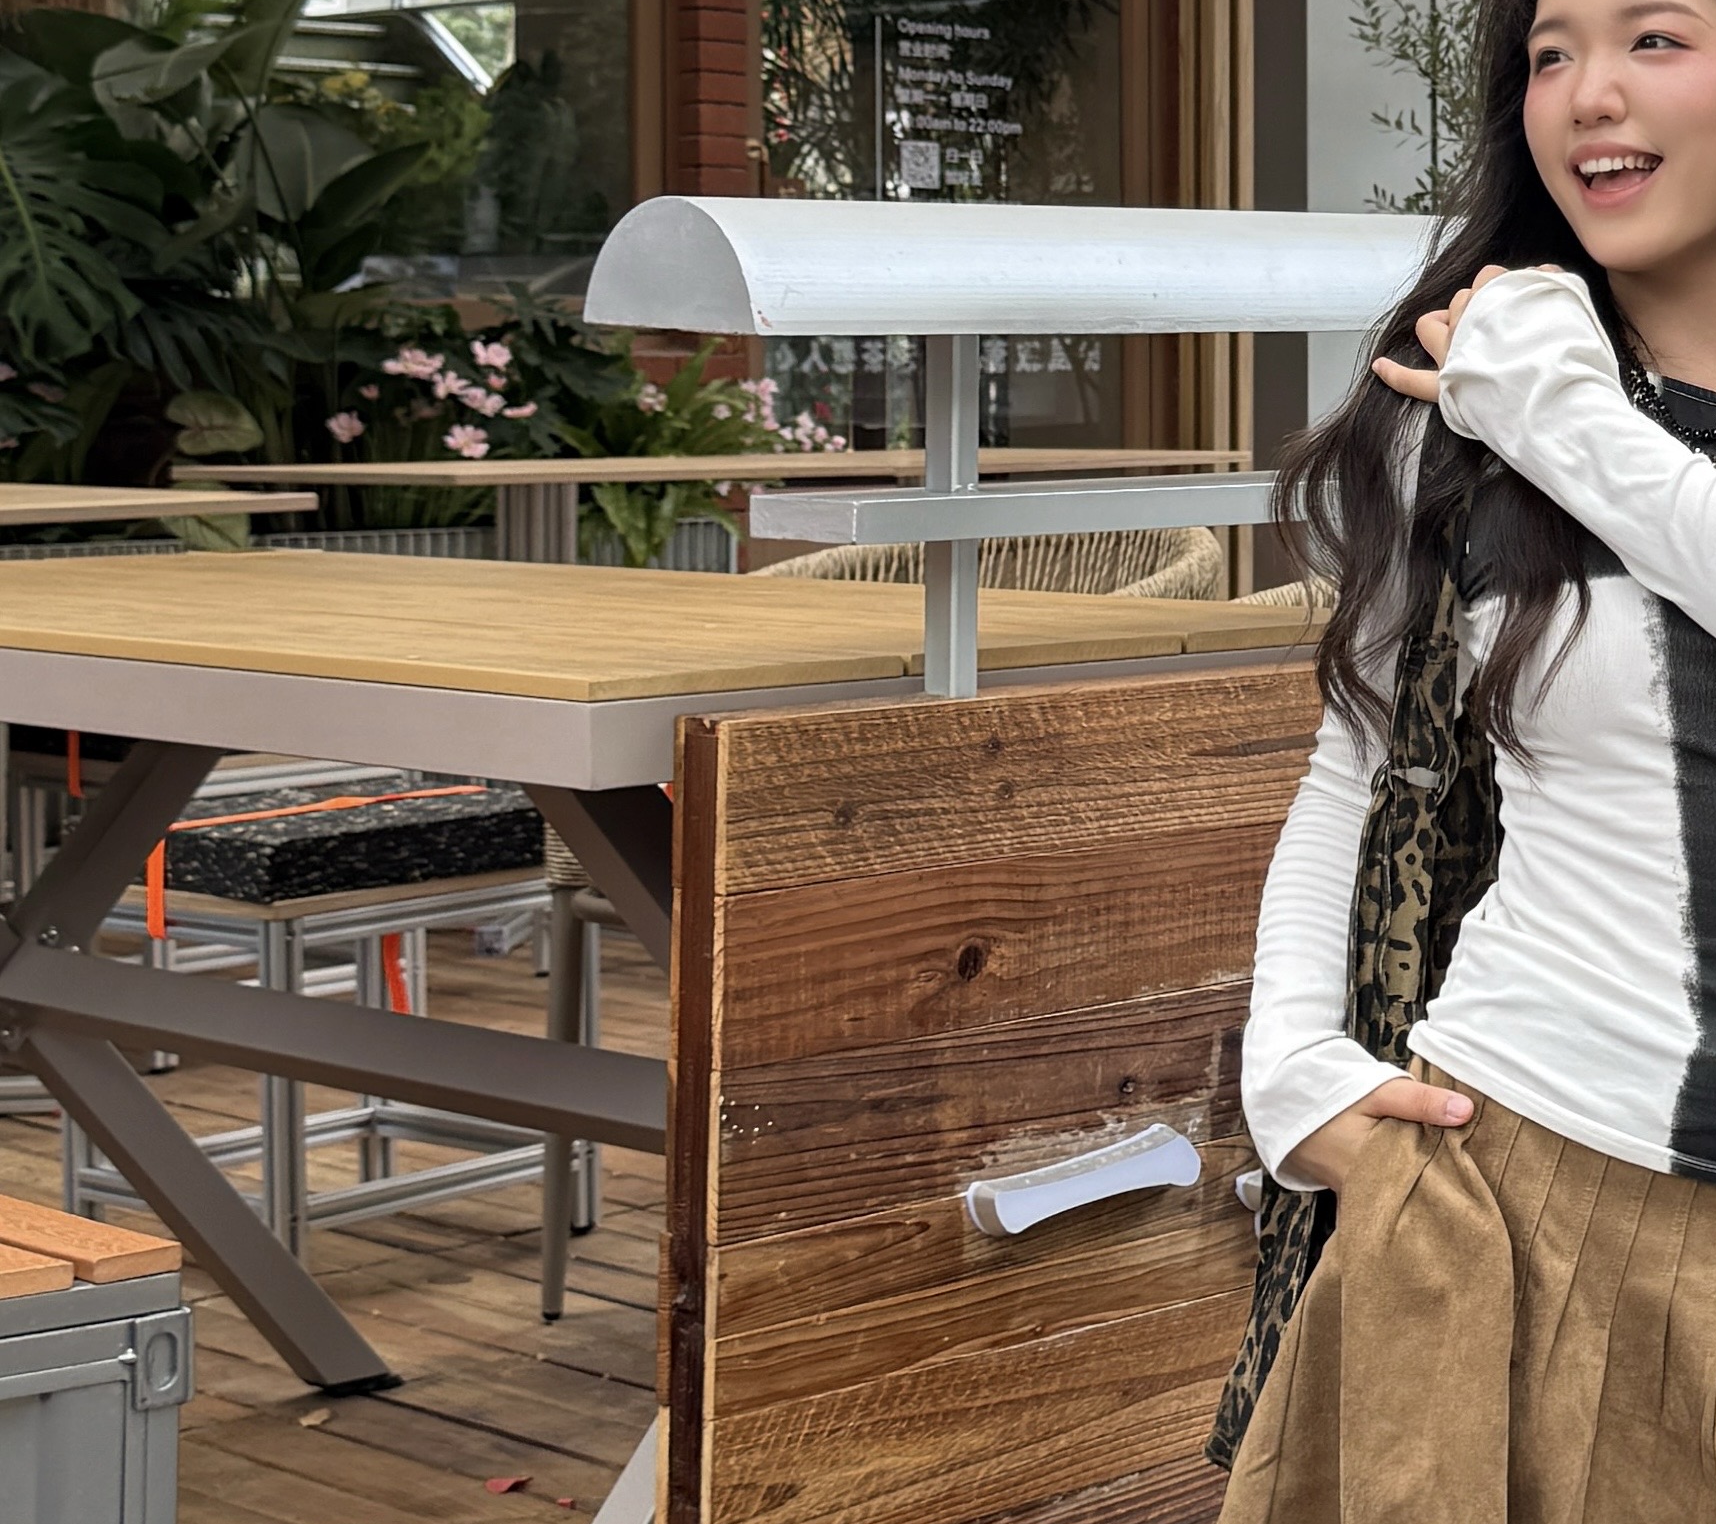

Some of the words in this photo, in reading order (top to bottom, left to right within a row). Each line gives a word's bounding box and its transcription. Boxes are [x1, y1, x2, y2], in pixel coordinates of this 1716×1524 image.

[897, 17, 952, 40] Opening
[954, 24, 991, 40] hours
[897, 66, 949, 89] Monday
[965, 70, 1013, 91] Sunday
